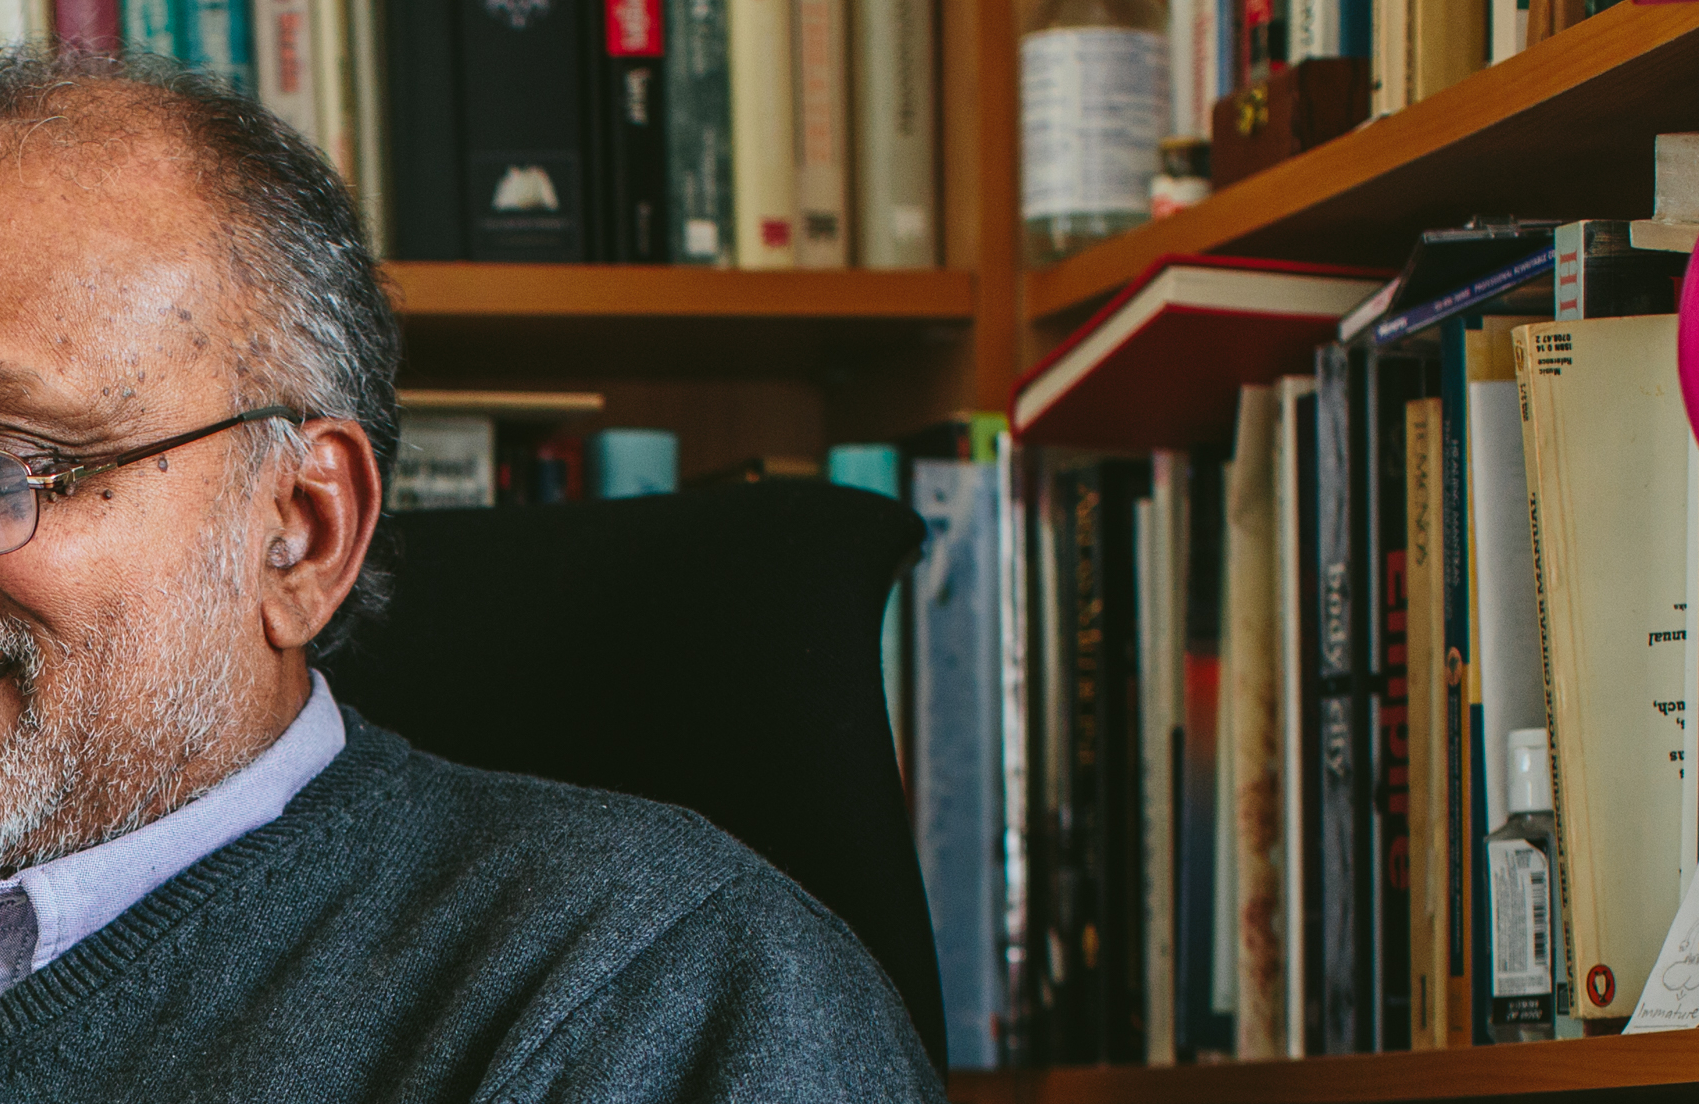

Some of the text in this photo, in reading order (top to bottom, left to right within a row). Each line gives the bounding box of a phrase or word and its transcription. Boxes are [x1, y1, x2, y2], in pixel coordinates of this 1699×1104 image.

[1547, 343, 1553, 352] 0
[1554, 342, 1573, 352] ISBN
[1537, 356, 1573, 367] Reference
[1539, 367, 1562, 377] Music
[1538, 598, 1552, 686] GUITAR
[1544, 690, 1557, 750] FOLK
[1549, 751, 1565, 857] PENGUIN
